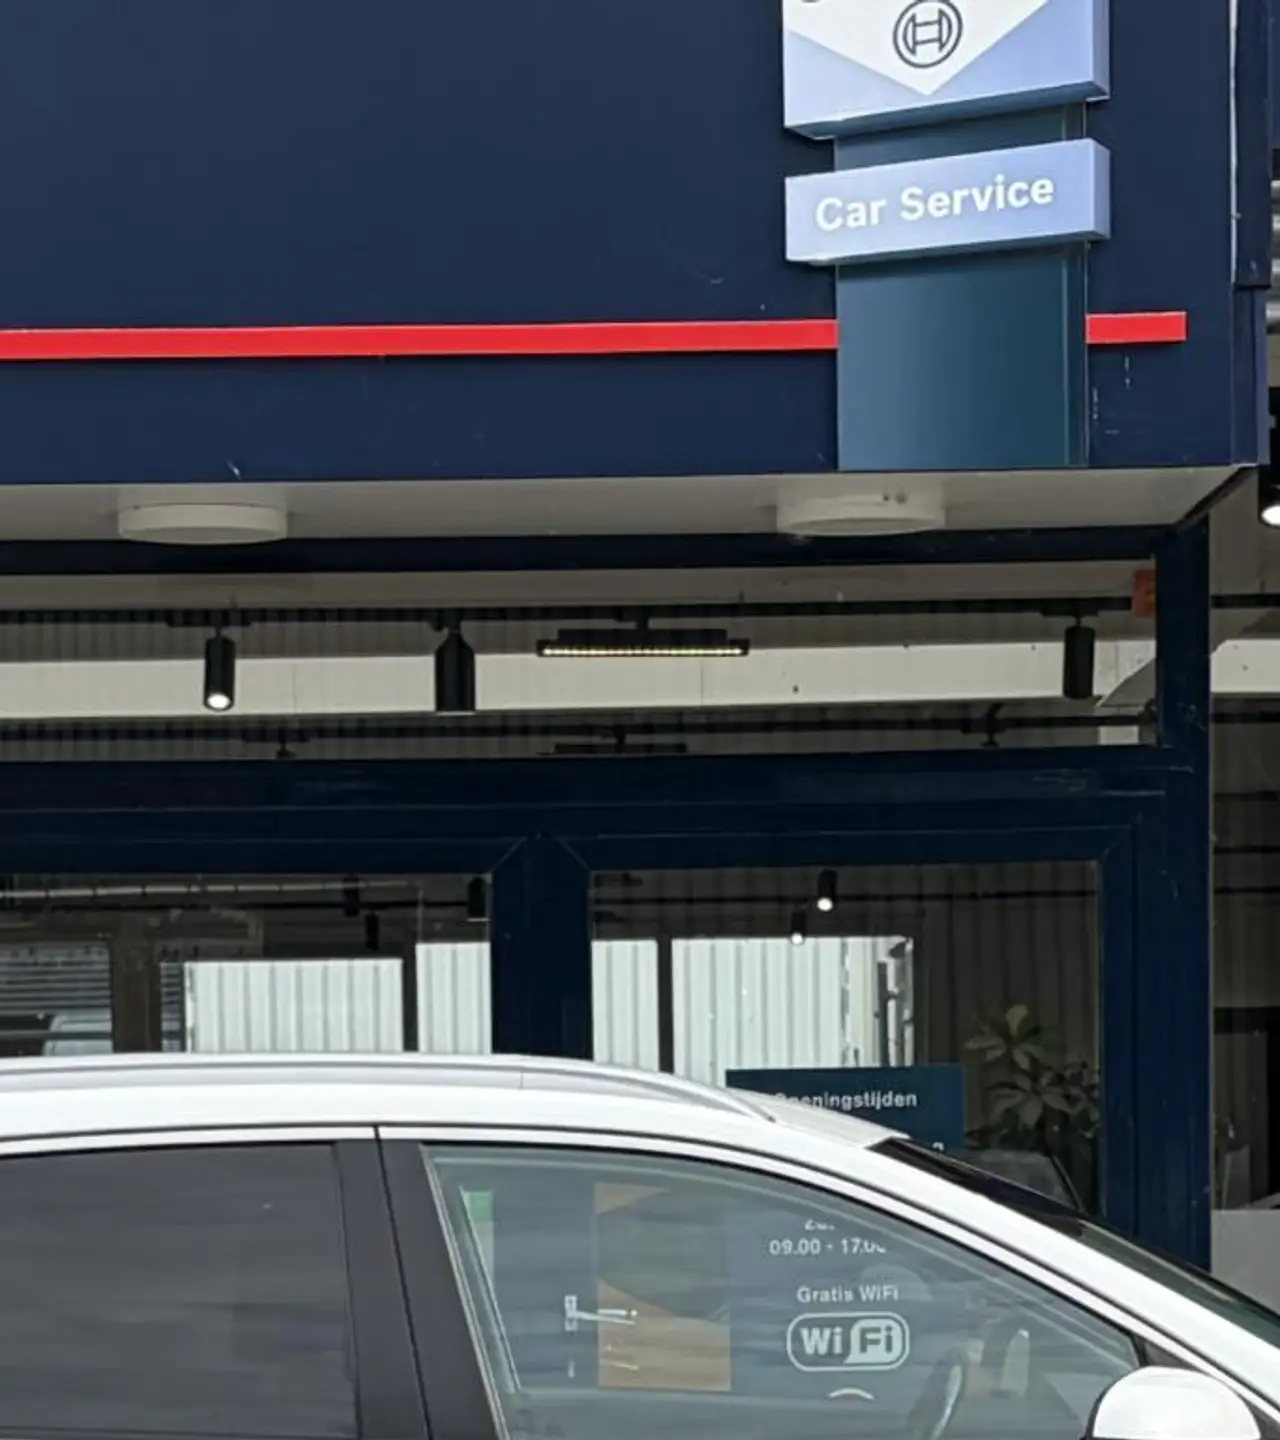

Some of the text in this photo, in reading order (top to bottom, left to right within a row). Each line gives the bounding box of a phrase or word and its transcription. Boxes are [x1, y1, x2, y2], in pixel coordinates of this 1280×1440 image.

[815, 173, 1055, 231] Car Service
[775, 1090, 918, 1111] eningstijden
[769, 1237, 822, 1256] 09.00
[796, 1283, 900, 1303] Gratis WiFi
